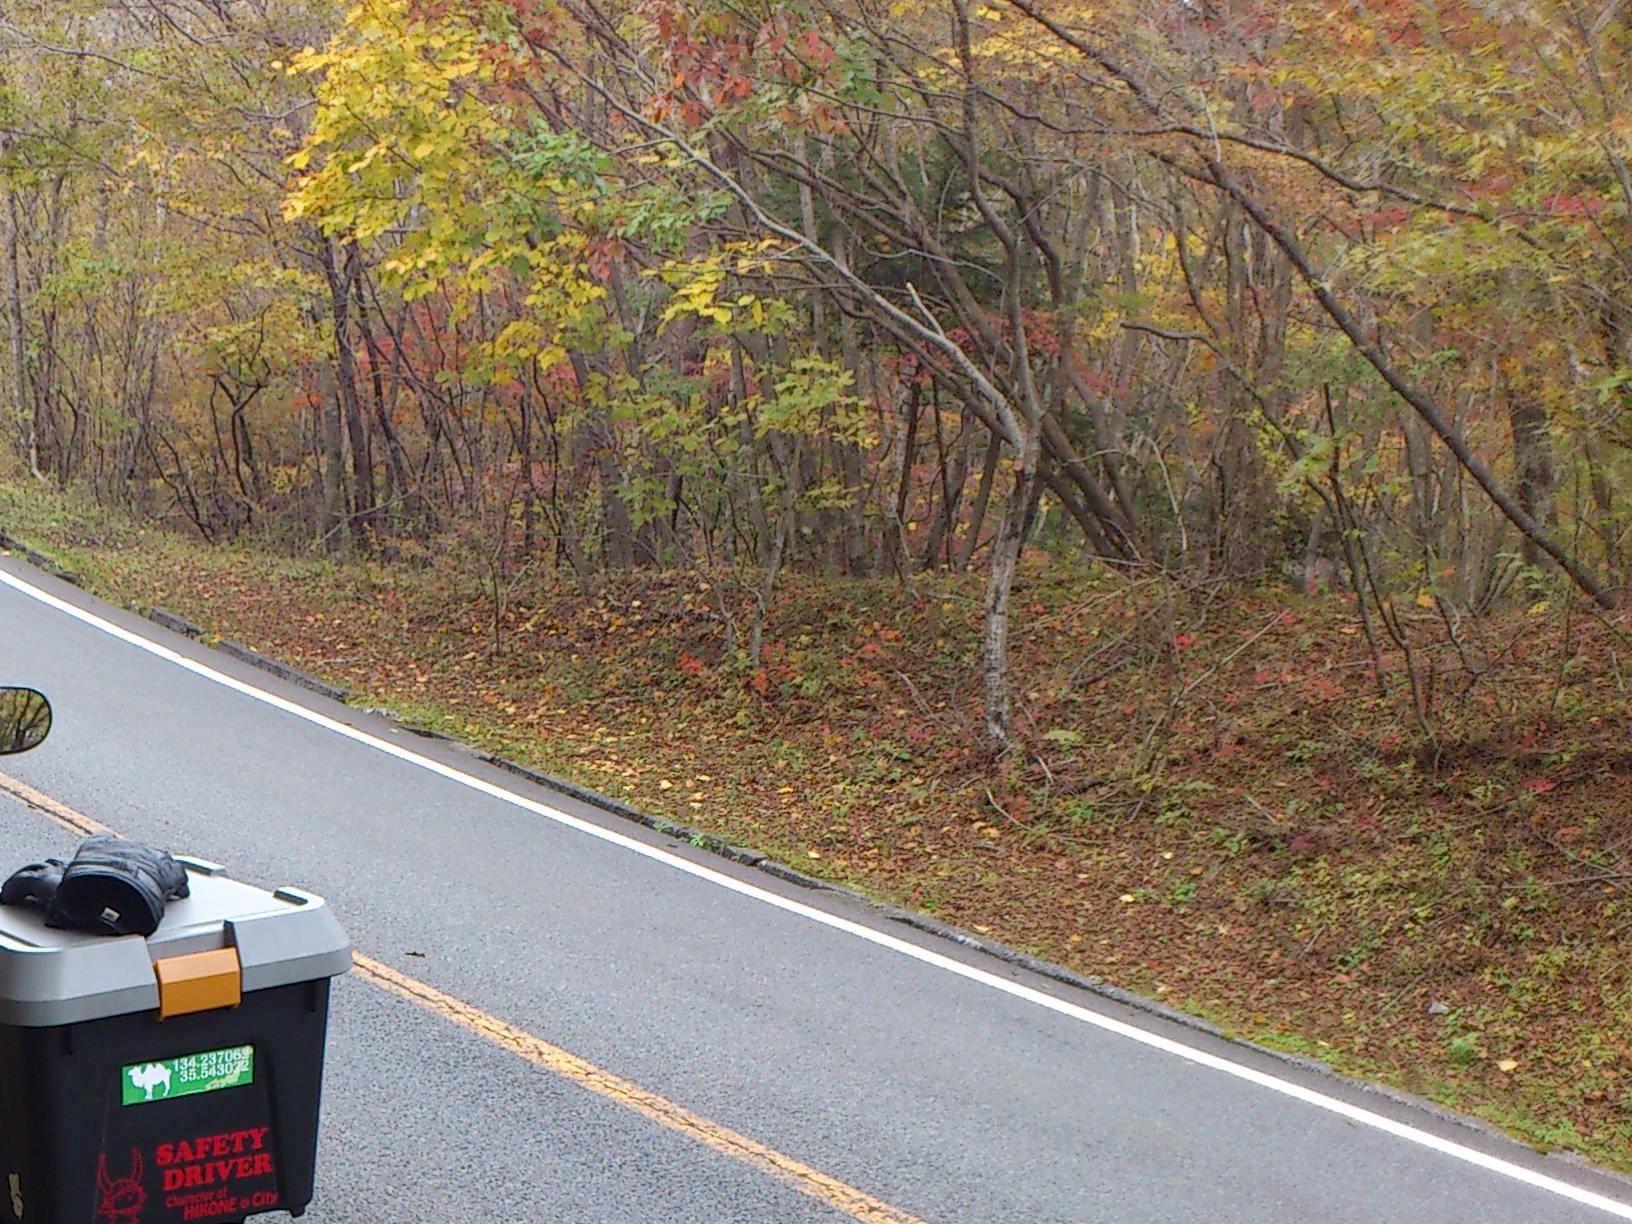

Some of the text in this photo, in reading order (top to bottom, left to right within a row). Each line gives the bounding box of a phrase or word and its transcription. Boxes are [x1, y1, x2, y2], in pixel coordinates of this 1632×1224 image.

[156, 1127, 269, 1166] SAFETY
[163, 1153, 273, 1191] DRIVER
[184, 1197, 237, 1220] HIKONE
